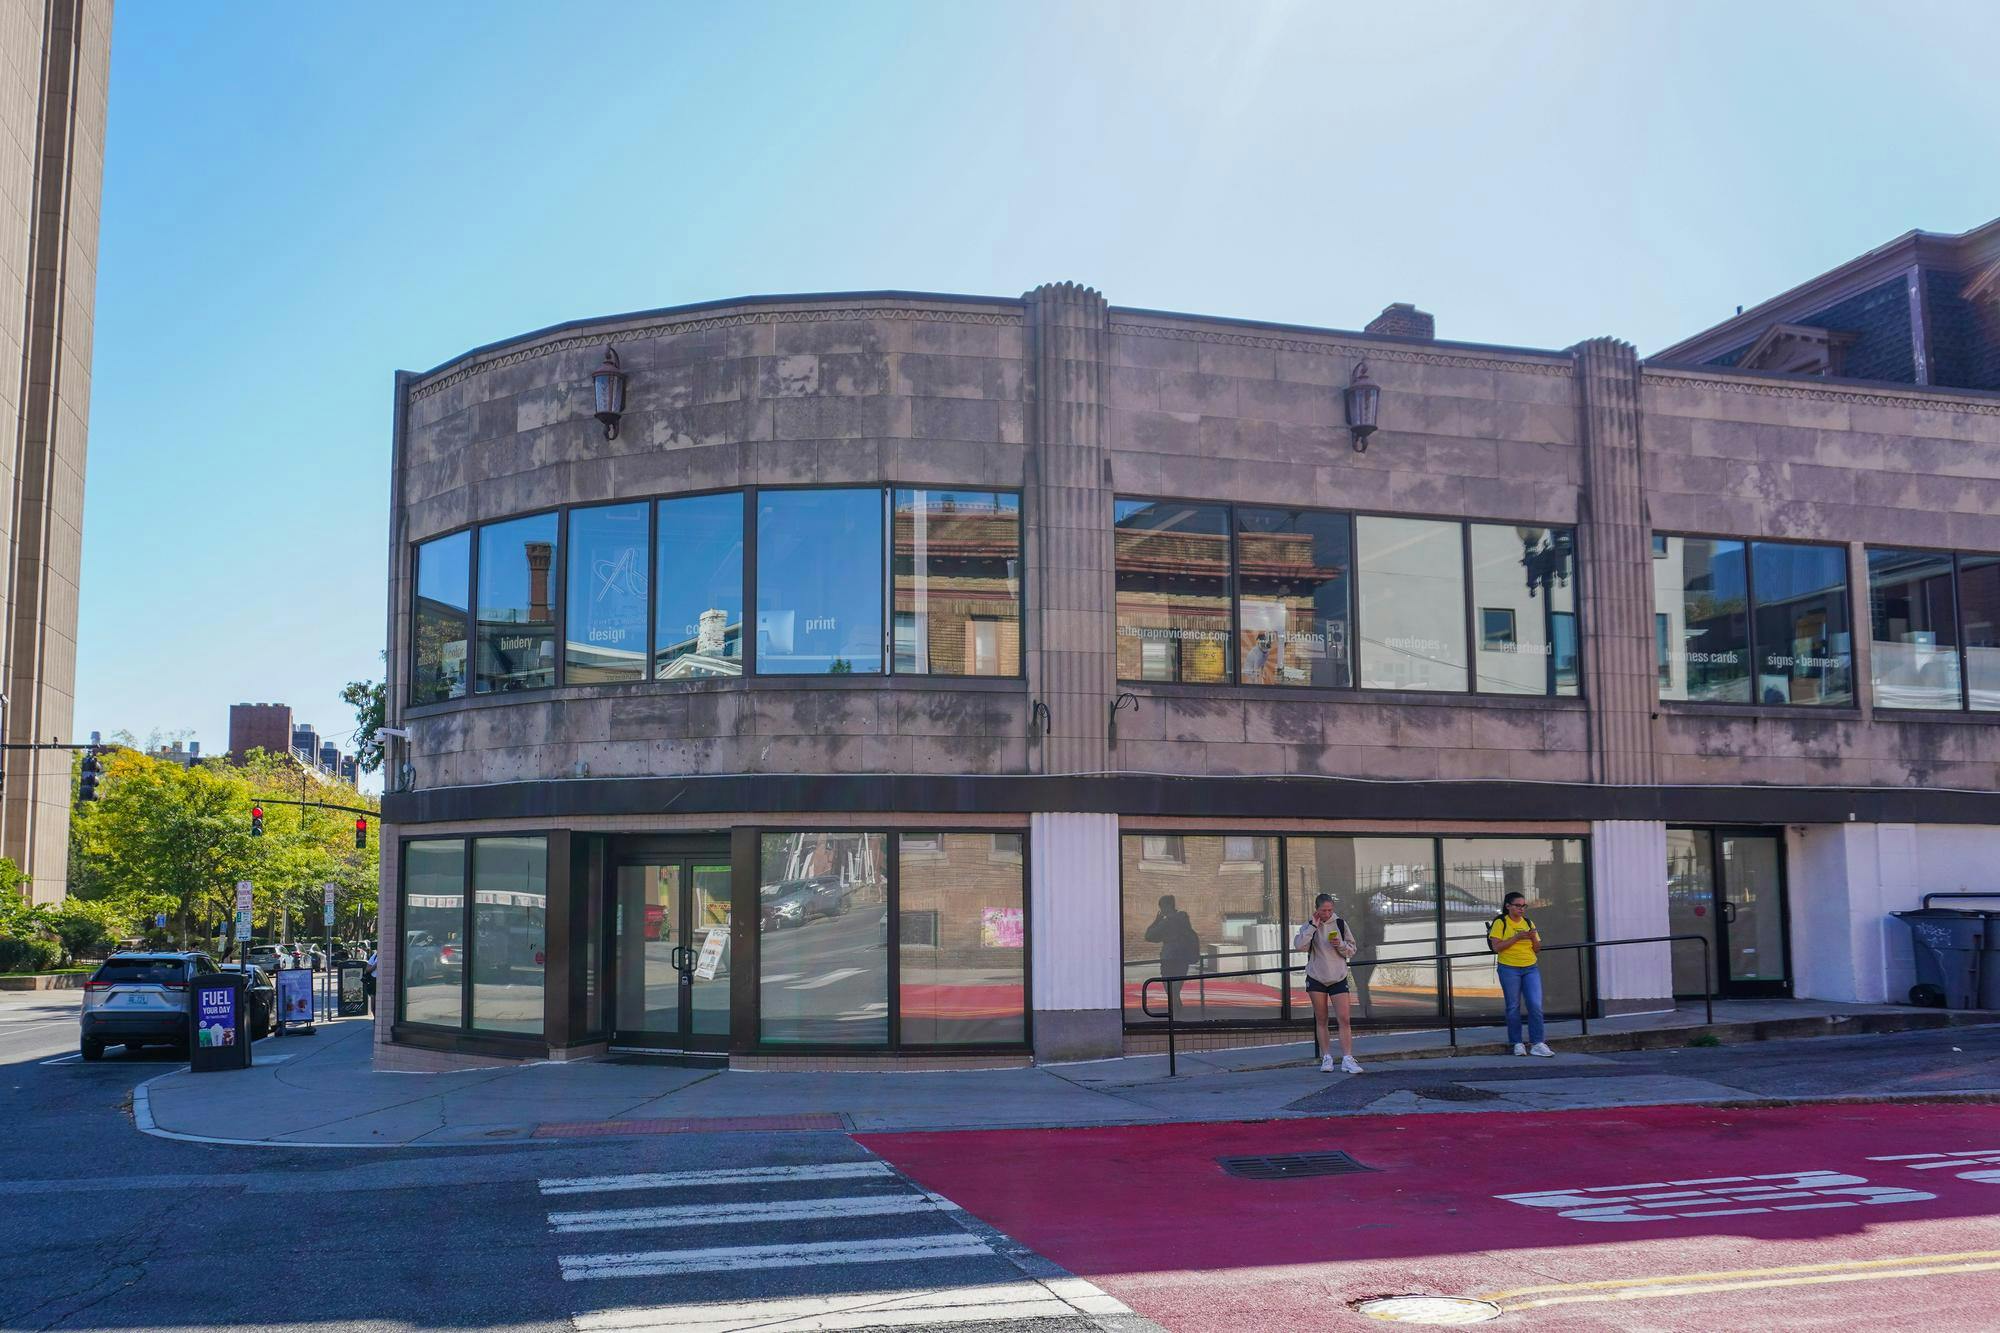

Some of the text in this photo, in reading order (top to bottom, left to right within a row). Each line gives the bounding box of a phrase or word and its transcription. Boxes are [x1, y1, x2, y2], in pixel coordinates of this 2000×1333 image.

[805, 616, 836, 634] print
[589, 627, 625, 643] design
[1119, 626, 1229, 641] allegraprovidence.com
[501, 636, 533, 651] bindery
[1385, 635, 1441, 651] envelopes
[1500, 639, 1552, 655] letterhead
[1711, 651, 1738, 663] cards
[1768, 652, 1840, 668] signs banners
[202, 990, 231, 1006] FUEL
[203, 1005, 231, 1015] YOUR DAY
